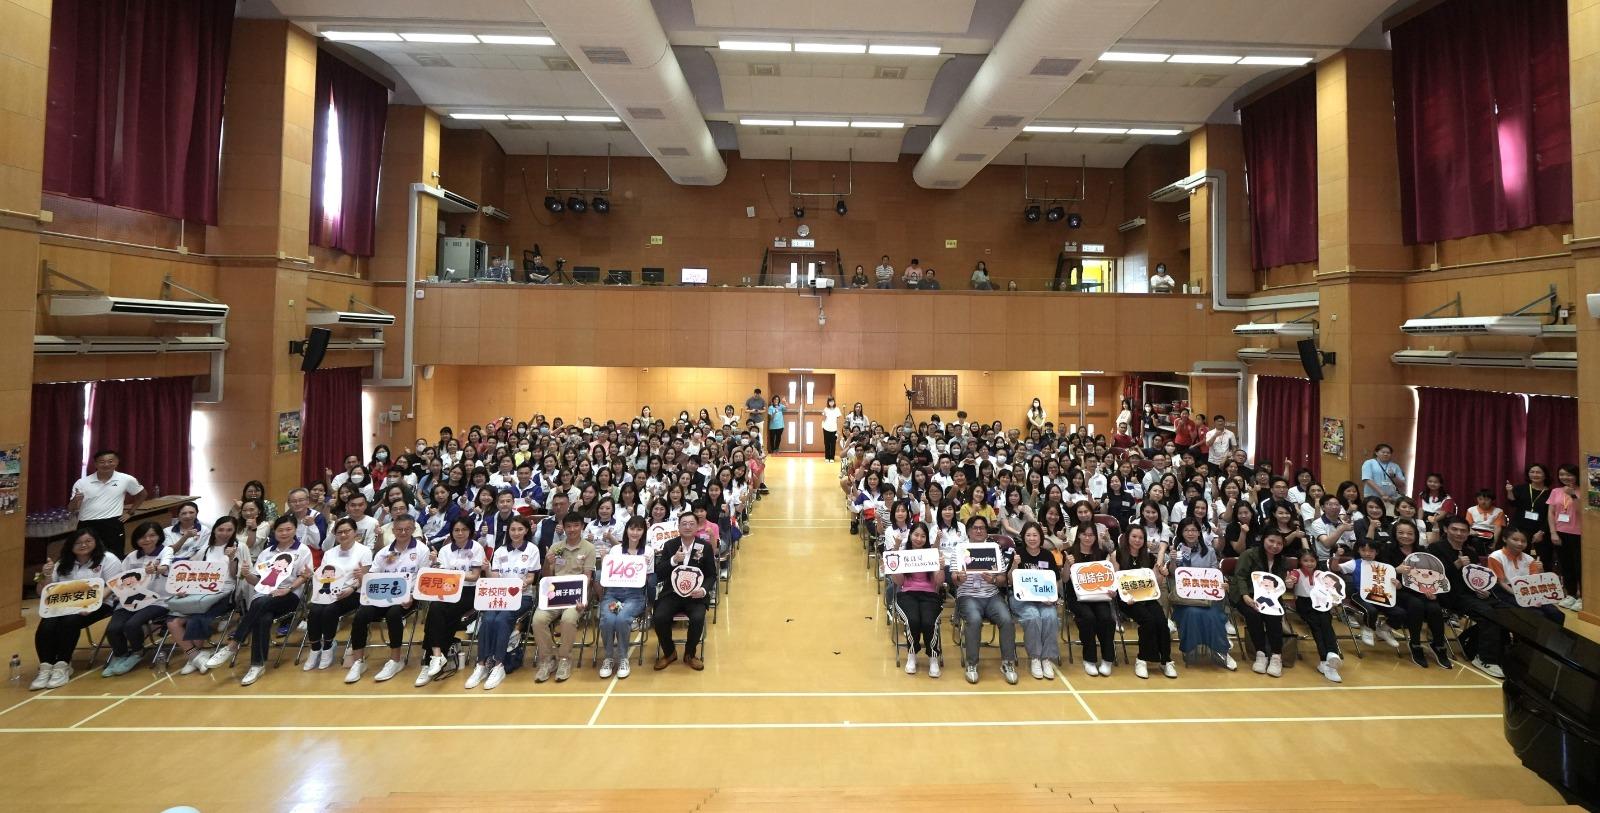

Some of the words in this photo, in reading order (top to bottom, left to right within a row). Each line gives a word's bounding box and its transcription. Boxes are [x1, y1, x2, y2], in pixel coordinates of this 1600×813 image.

[175, 571, 221, 583] 保良精神
[368, 583, 391, 594] 親子
[1181, 577, 1220, 589] 保良精神
[555, 588, 582, 597] 親子教育
[1033, 585, 1054, 593] Talk!
[46, 589, 98, 605] 保赤安良
